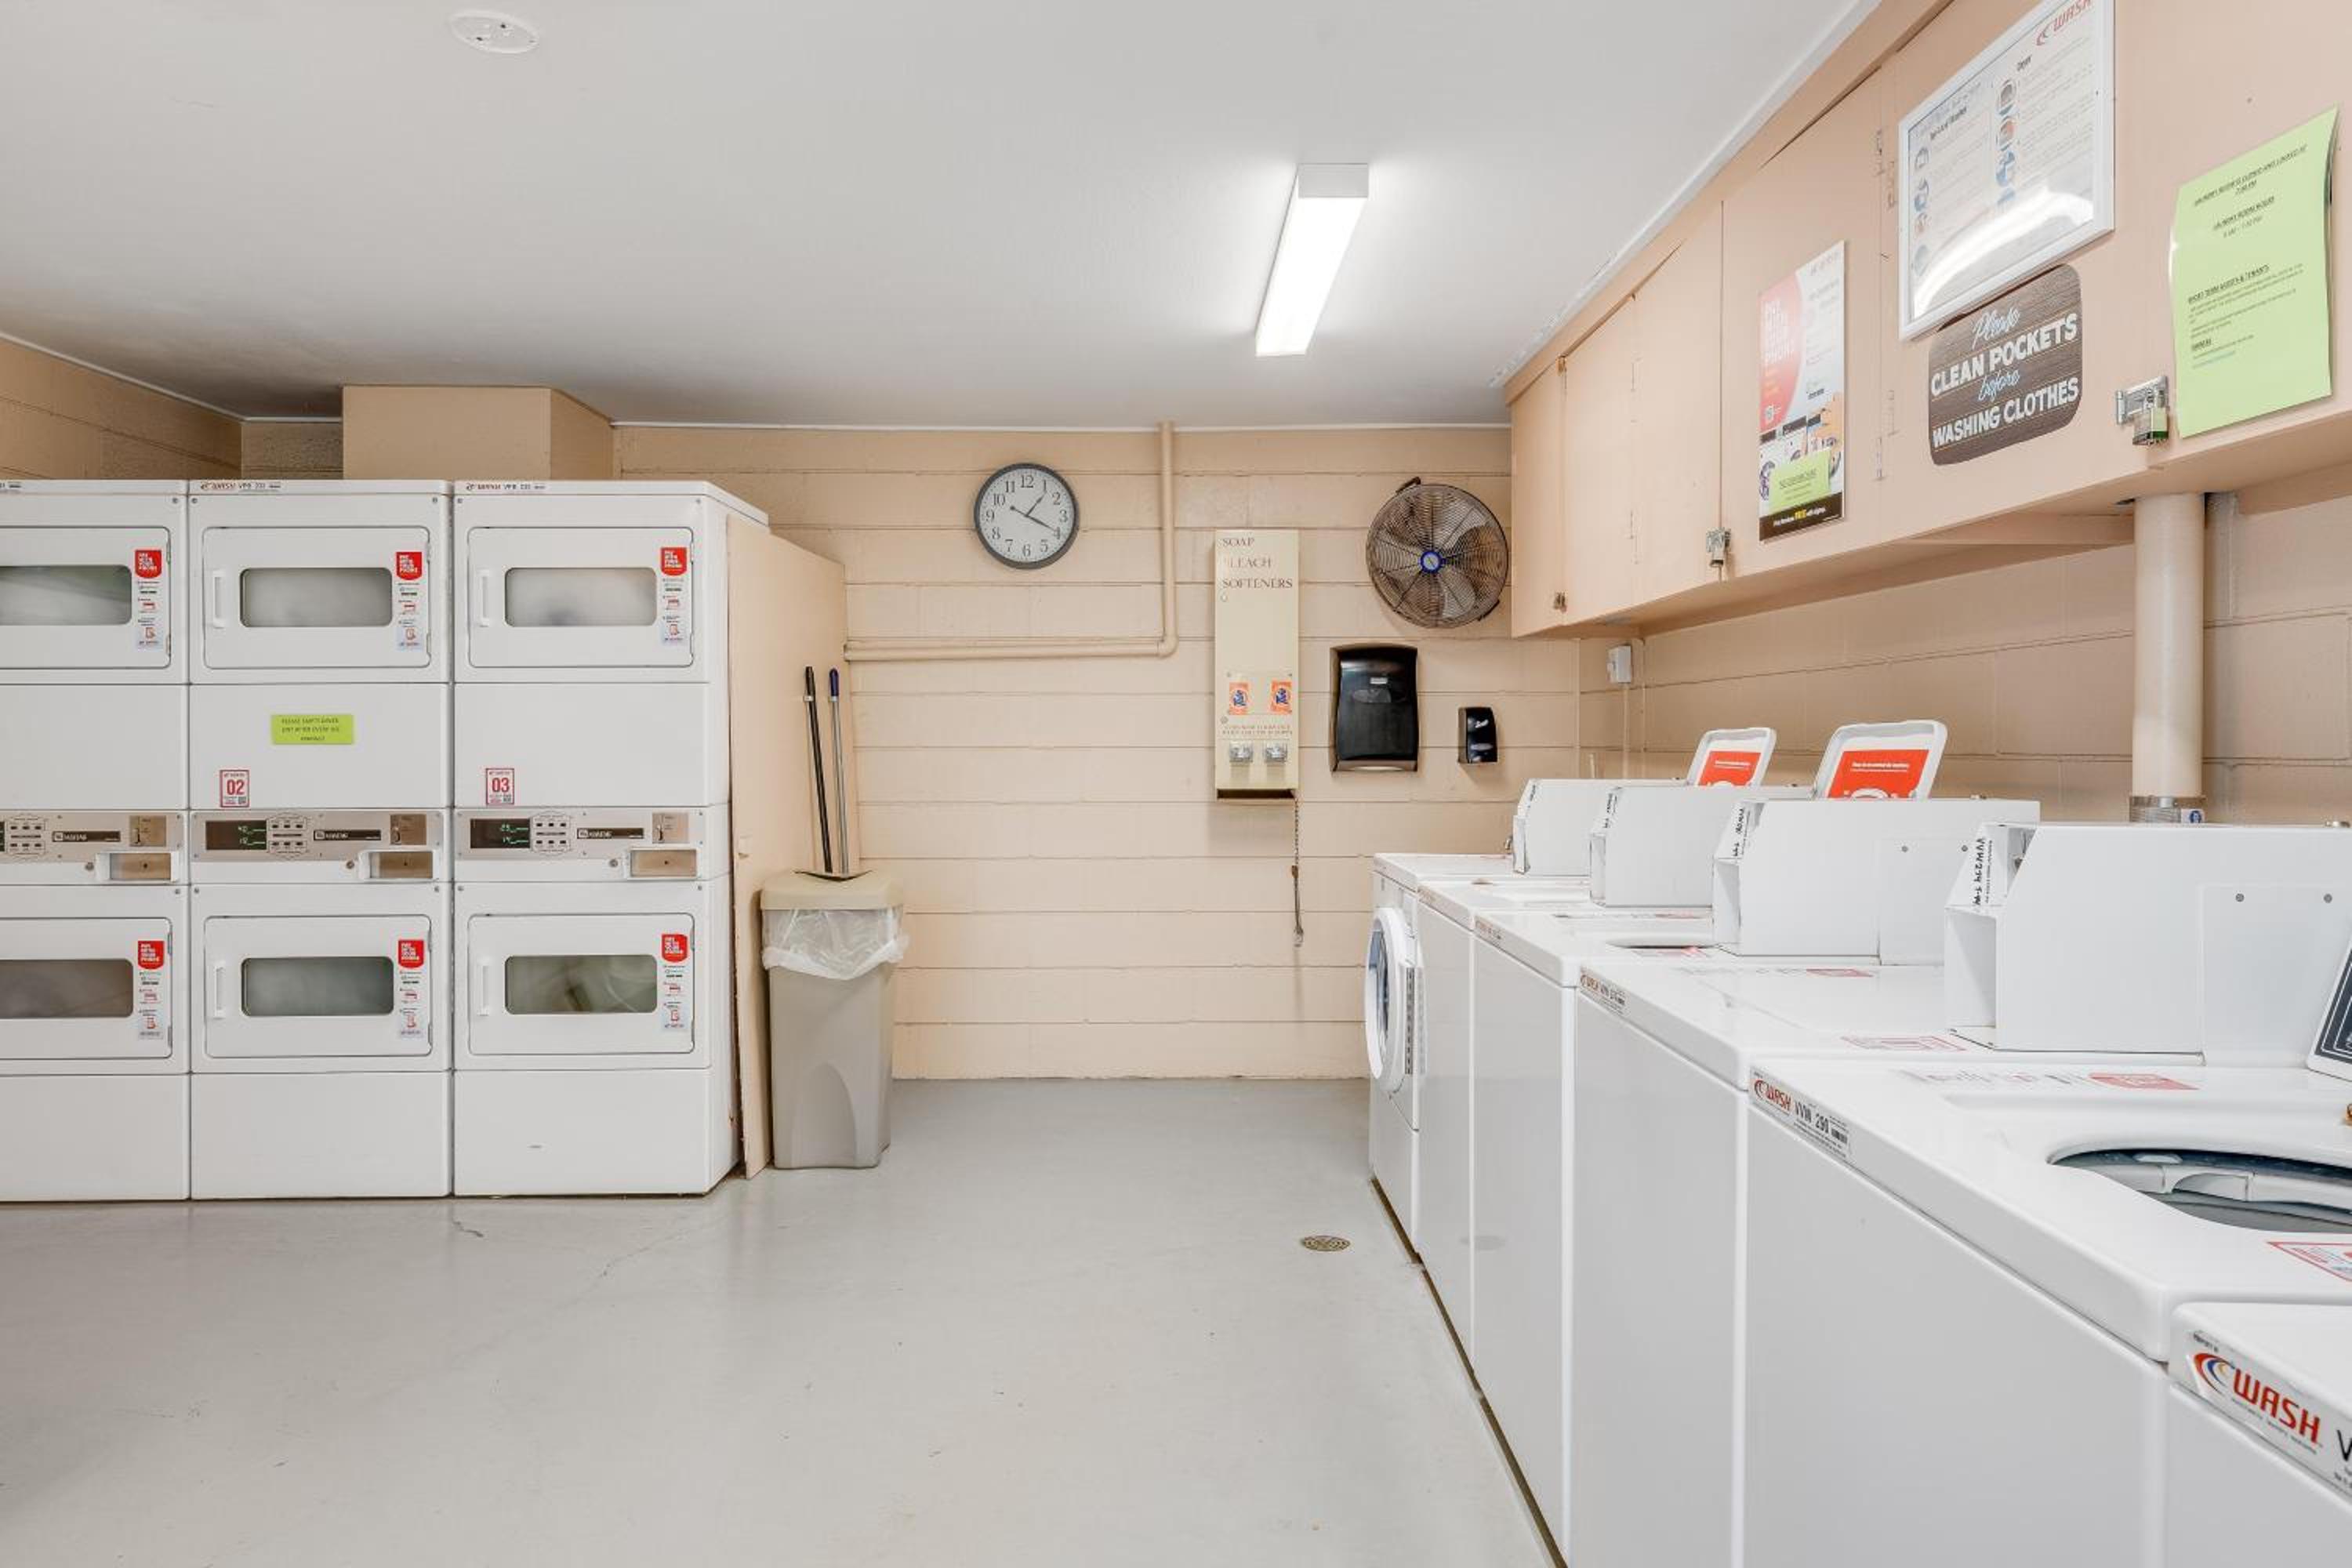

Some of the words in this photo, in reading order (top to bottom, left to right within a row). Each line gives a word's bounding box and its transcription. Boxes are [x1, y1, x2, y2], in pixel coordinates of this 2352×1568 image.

[1930, 353, 1984, 397] CLEAN
[1989, 312, 2078, 372] POCKETS
[1977, 369, 2021, 402] before
[1932, 405, 2000, 448] WASHING
[2003, 376, 2079, 424] CLOTHES
[1006, 480, 1016, 493] 11
[1020, 474, 1034, 488] 12
[993, 493, 1006, 506] 10
[1052, 492, 1062, 506] 2
[985, 509, 995, 522] 9
[1059, 509, 1068, 523] 3
[992, 526, 1001, 540] 8
[1004, 539, 1014, 553] 7
[1040, 539, 1049, 553] 5
[1222, 537, 1255, 547] SOAP
[1022, 543, 1032, 557] 6
[1230, 557, 1272, 568] LEACH
[1221, 578, 1294, 589] SOFTENERS
[227, 779, 245, 796] 02
[492, 777, 510, 793] 03
[1766, 1085, 1792, 1112] WASH
[2234, 1367, 2321, 1444] WASH
